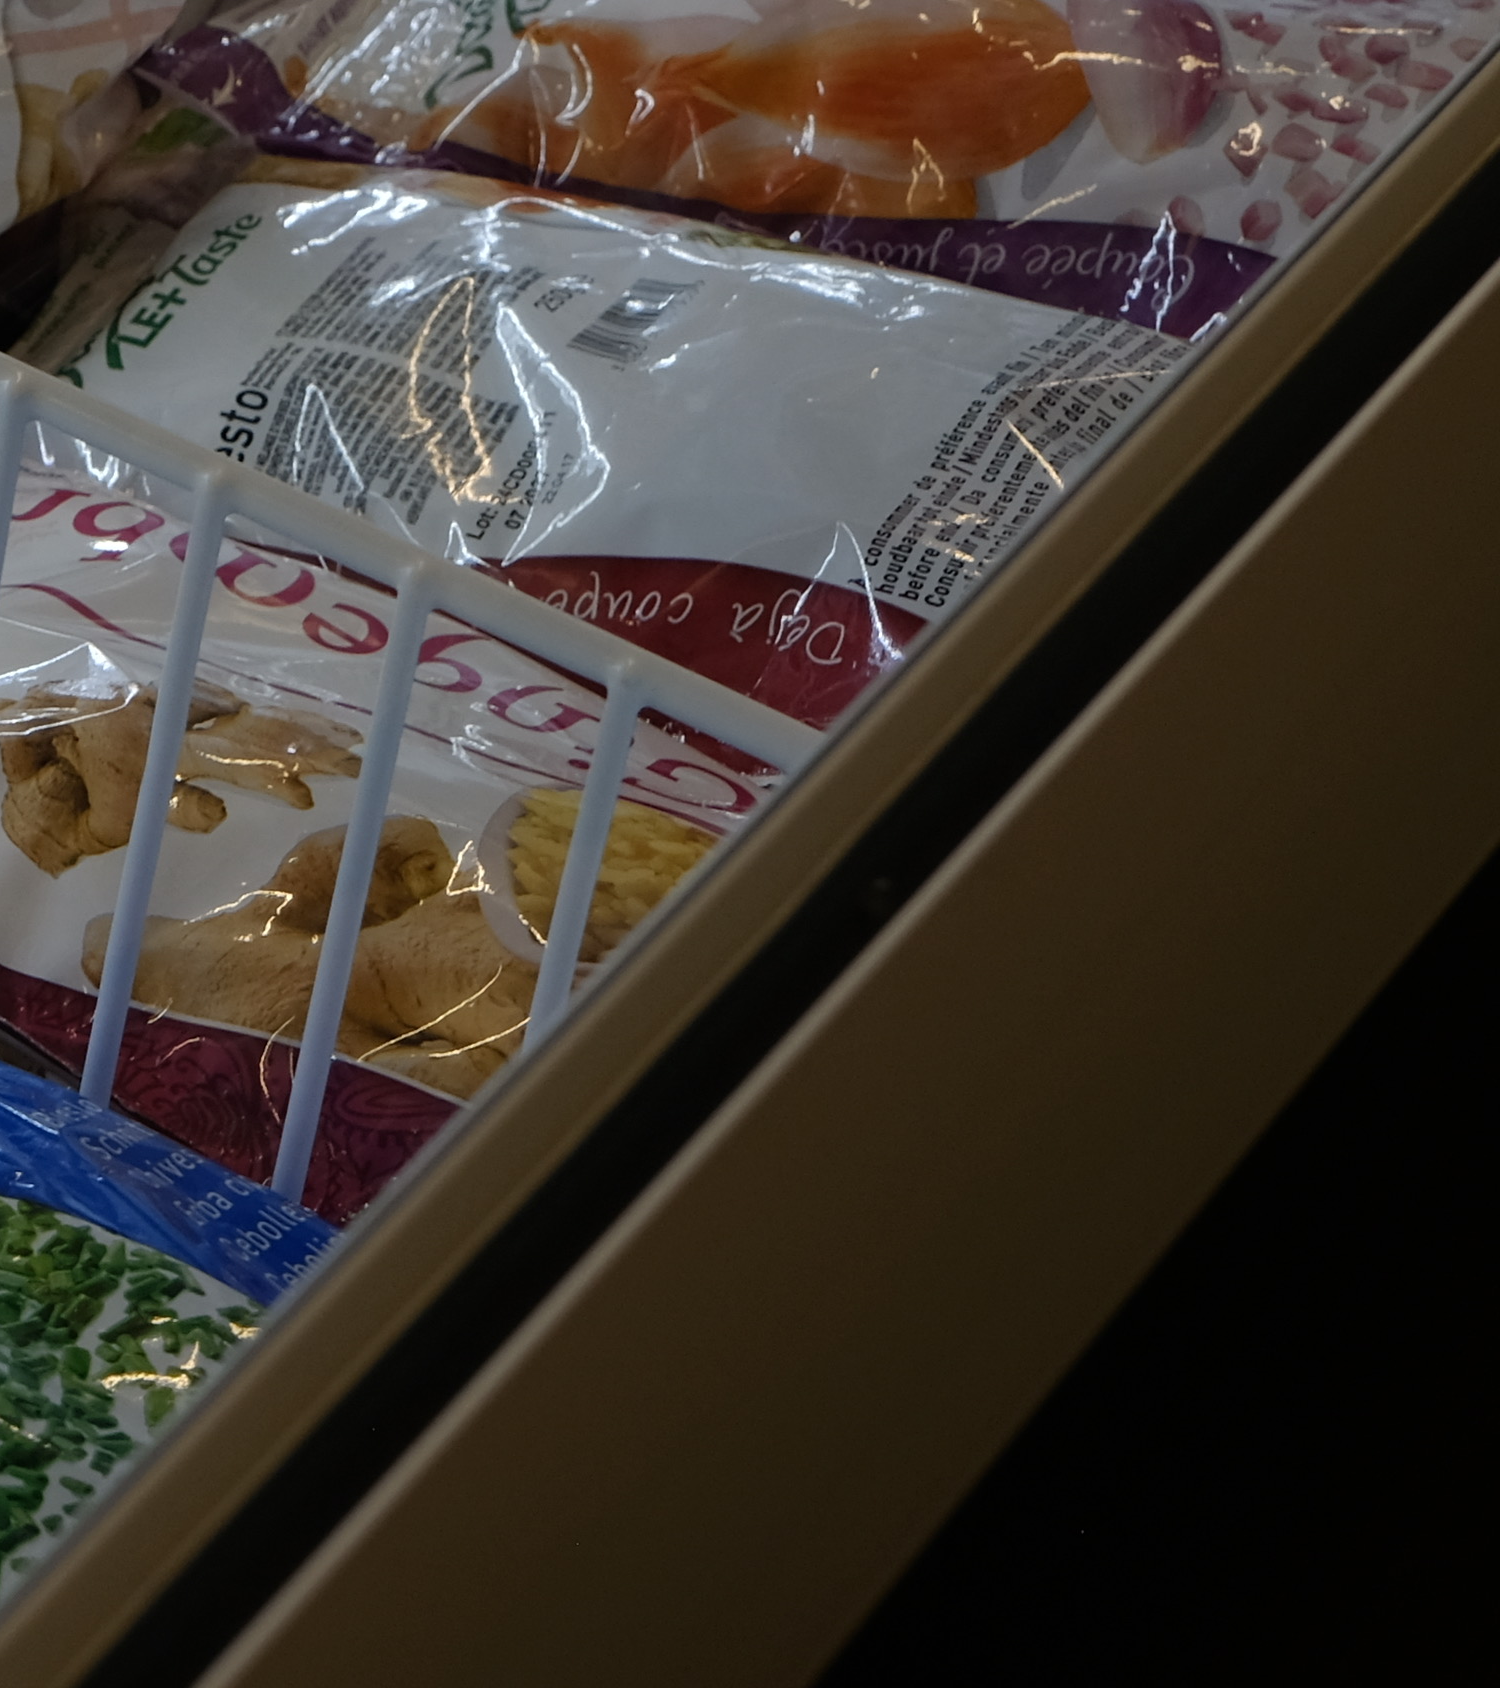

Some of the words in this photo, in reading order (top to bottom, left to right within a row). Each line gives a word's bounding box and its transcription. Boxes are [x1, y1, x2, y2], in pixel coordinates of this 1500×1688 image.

[116, 211, 264, 351] LE+Taste
[1110, 389, 1136, 411] de
[913, 473, 937, 493] de
[930, 397, 987, 472] préférence
[898, 544, 942, 603] before
[728, 590, 848, 667] Déjà
